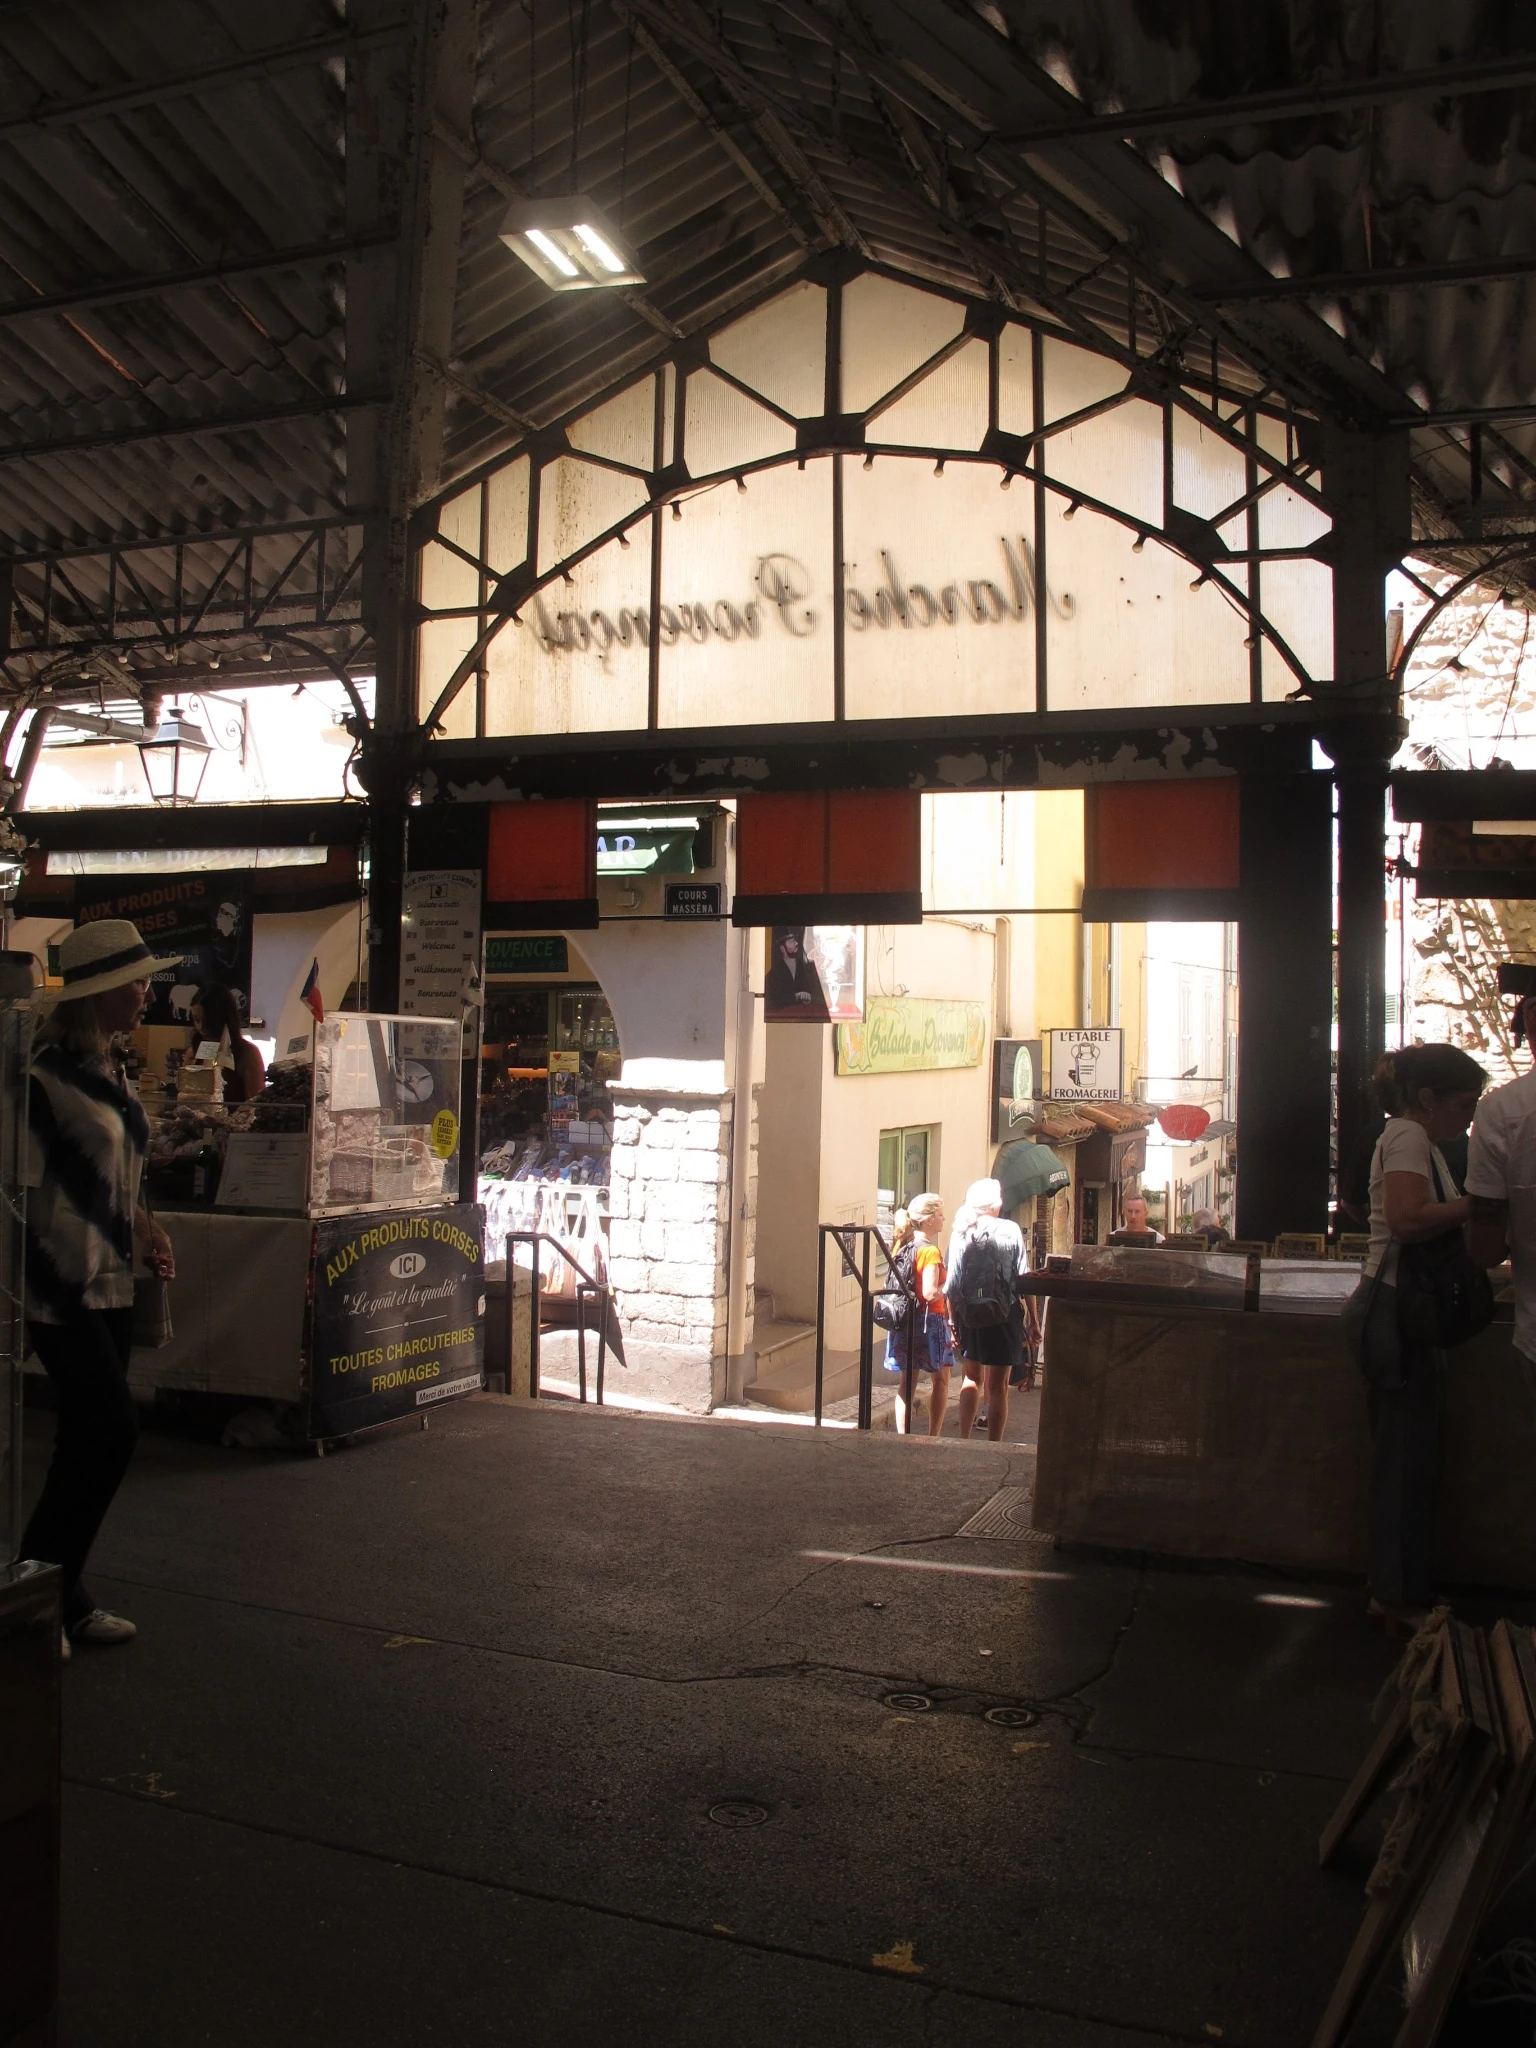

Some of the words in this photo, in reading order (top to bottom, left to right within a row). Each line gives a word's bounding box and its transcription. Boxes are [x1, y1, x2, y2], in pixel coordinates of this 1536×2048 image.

[79, 900, 115, 923] AUX
[117, 879, 206, 913] PRODUITS
[678, 890, 707, 901] COURS
[422, 941, 457, 950] Welcome
[413, 964, 463, 974] Willkommen
[417, 988, 457, 998] Benvenuto
[869, 1016, 911, 1058] Balade
[921, 1016, 965, 1056] Provence
[1060, 1031, 1111, 1042] L'ETABLE
[1054, 1088, 1118, 1099] FROMAGERIE
[438, 1117, 454, 1128] PLUS
[326, 1241, 359, 1287] AUX
[361, 1218, 429, 1256] PRODUITS
[432, 1219, 479, 1264] CORSES
[399, 1255, 416, 1275] ICI
[396, 1287, 407, 1305] et
[408, 1285, 420, 1303] la
[329, 1347, 384, 1376] TOUTES
[386, 1326, 475, 1362] CHARCUTERIES
[371, 1361, 440, 1393] FROMAGES
[419, 1389, 436, 1402] Merci
[437, 1388, 445, 1397] de
[446, 1384, 462, 1394] votre
[462, 1379, 478, 1390] visite
